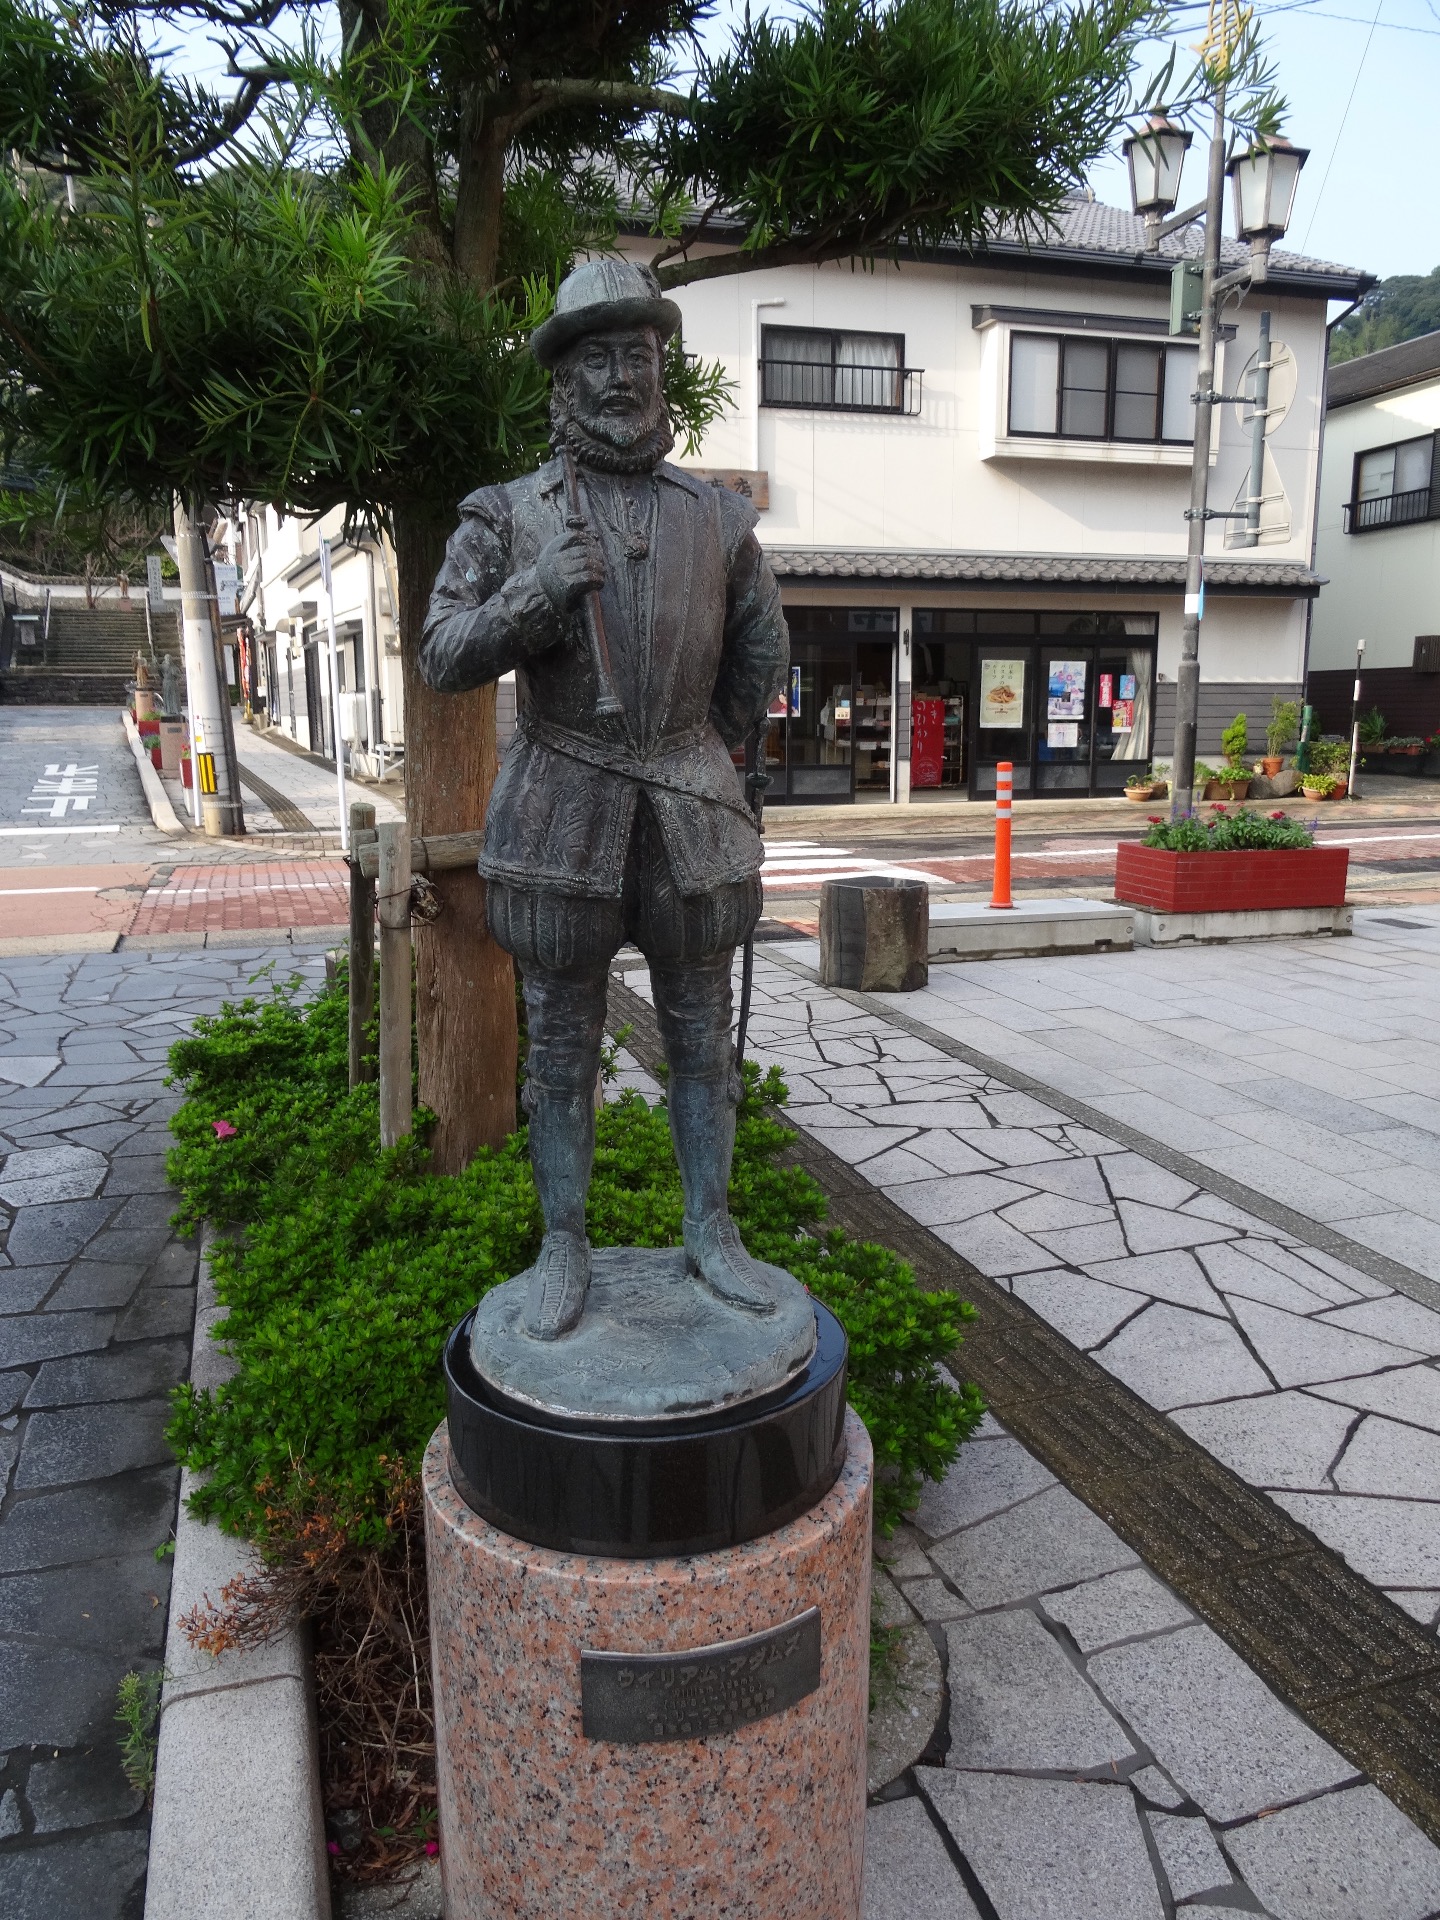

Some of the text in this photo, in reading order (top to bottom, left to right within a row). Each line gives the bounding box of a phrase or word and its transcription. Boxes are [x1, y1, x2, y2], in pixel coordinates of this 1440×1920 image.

[20, 763, 99, 817] 止まれ
[618, 1633, 800, 1689] ウィリアム・アダムス
